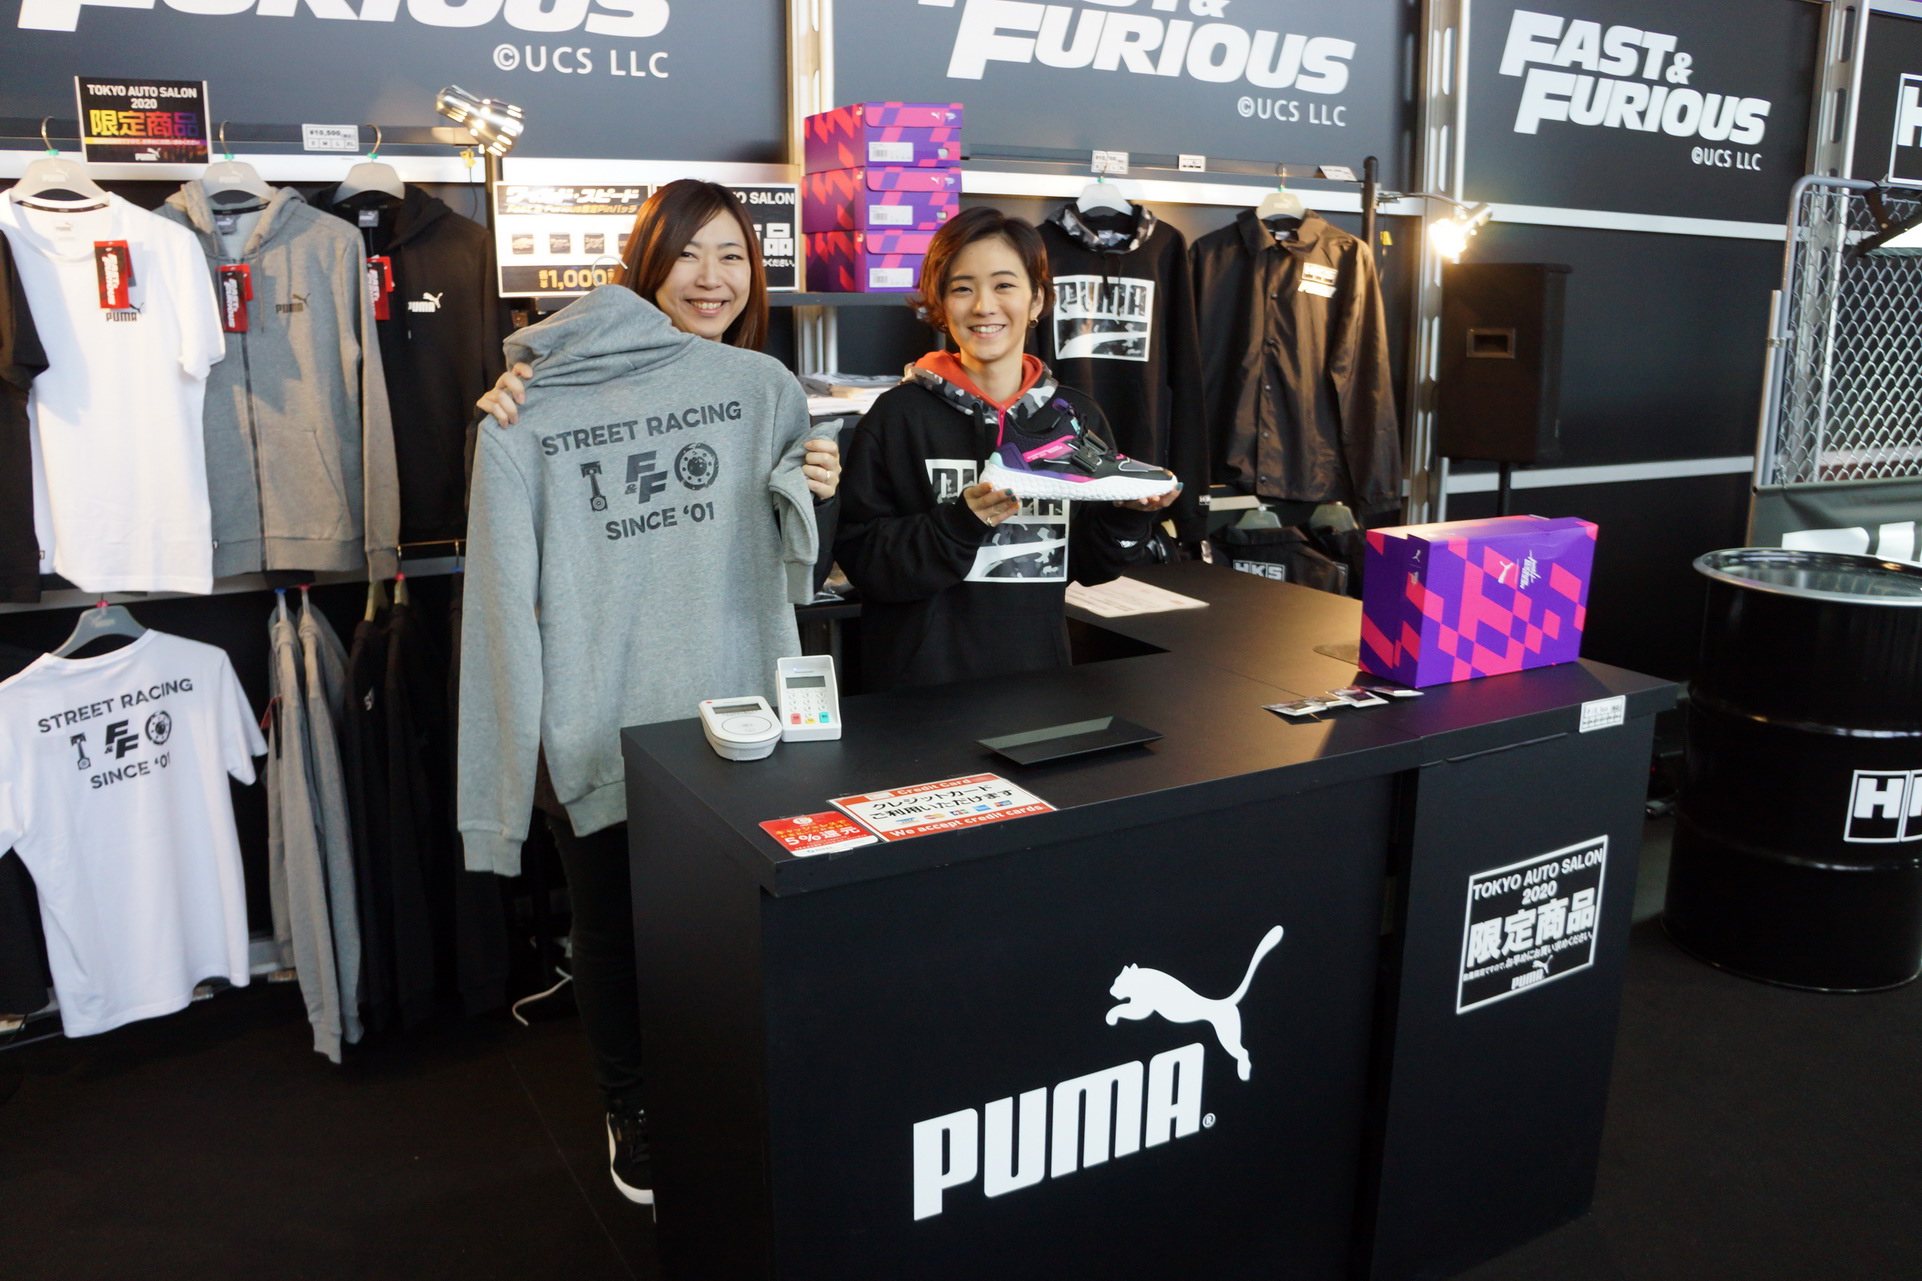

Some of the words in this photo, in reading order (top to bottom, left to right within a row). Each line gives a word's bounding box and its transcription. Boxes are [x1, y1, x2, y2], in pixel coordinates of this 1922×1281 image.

[946, 0, 1356, 95] FURIOUS
[610, 50, 669, 78] LLC
[87, 84, 126, 97] TOKYO
[127, 86, 158, 97] AUTO
[159, 87, 197, 98] SALON
[130, 98, 157, 109] 2020
[1308, 102, 1346, 128] LLC
[1514, 68, 1771, 145] FURIOUS
[89, 109, 199, 137] 限定商品
[1736, 150, 1762, 171] LLC
[750, 191, 795, 204] SALON
[106, 312, 137, 322] PUMA
[408, 301, 436, 313] PUMA
[541, 420, 638, 456] STREET
[645, 400, 742, 437] RACING
[605, 507, 677, 541] SINCE
[38, 698, 114, 733] STREET
[120, 678, 193, 709] RACING
[90, 761, 150, 790] SINCE
[897, 783, 939, 795] Credit
[940, 778, 972, 788] Card
[869, 790, 1013, 819] ご利用いただけます
[872, 785, 992, 810] クレジットカード
[890, 828, 916, 838] We
[917, 819, 963, 833] accept
[964, 811, 1005, 824] credit
[1005, 804, 1044, 816] cards
[784, 826, 861, 846] 5%還元
[1472, 873, 1522, 901] TOKYO
[1523, 862, 1560, 887] AUTO
[1561, 848, 1603, 875] SALON
[1521, 880, 1558, 906] 2020
[1466, 887, 1596, 969] 限定商品
